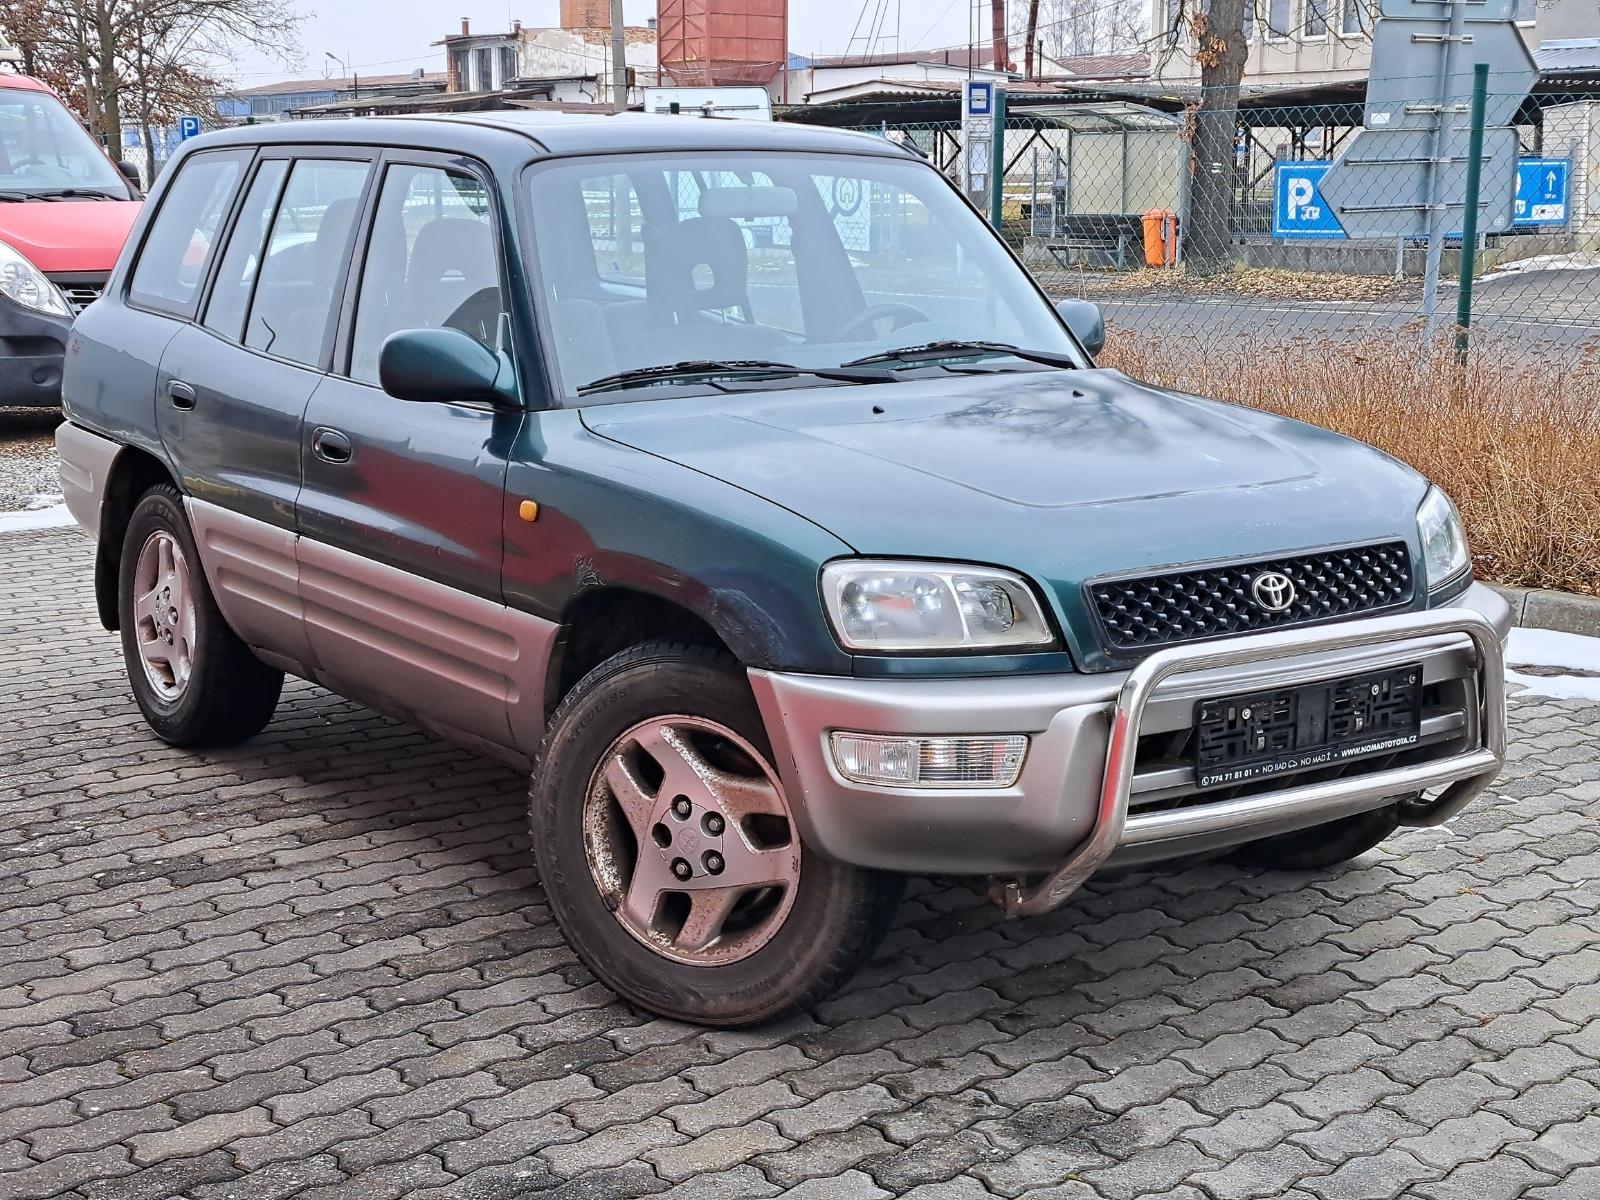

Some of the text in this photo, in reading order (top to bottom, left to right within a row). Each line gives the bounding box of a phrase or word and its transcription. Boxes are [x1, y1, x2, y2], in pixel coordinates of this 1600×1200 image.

[184, 119, 195, 135] P
[1288, 178, 1313, 220] P
[1210, 735, 1417, 784] 774 71 81 01 NO BAD NO MAD WWW.NOMADTOYOTA.CZ
